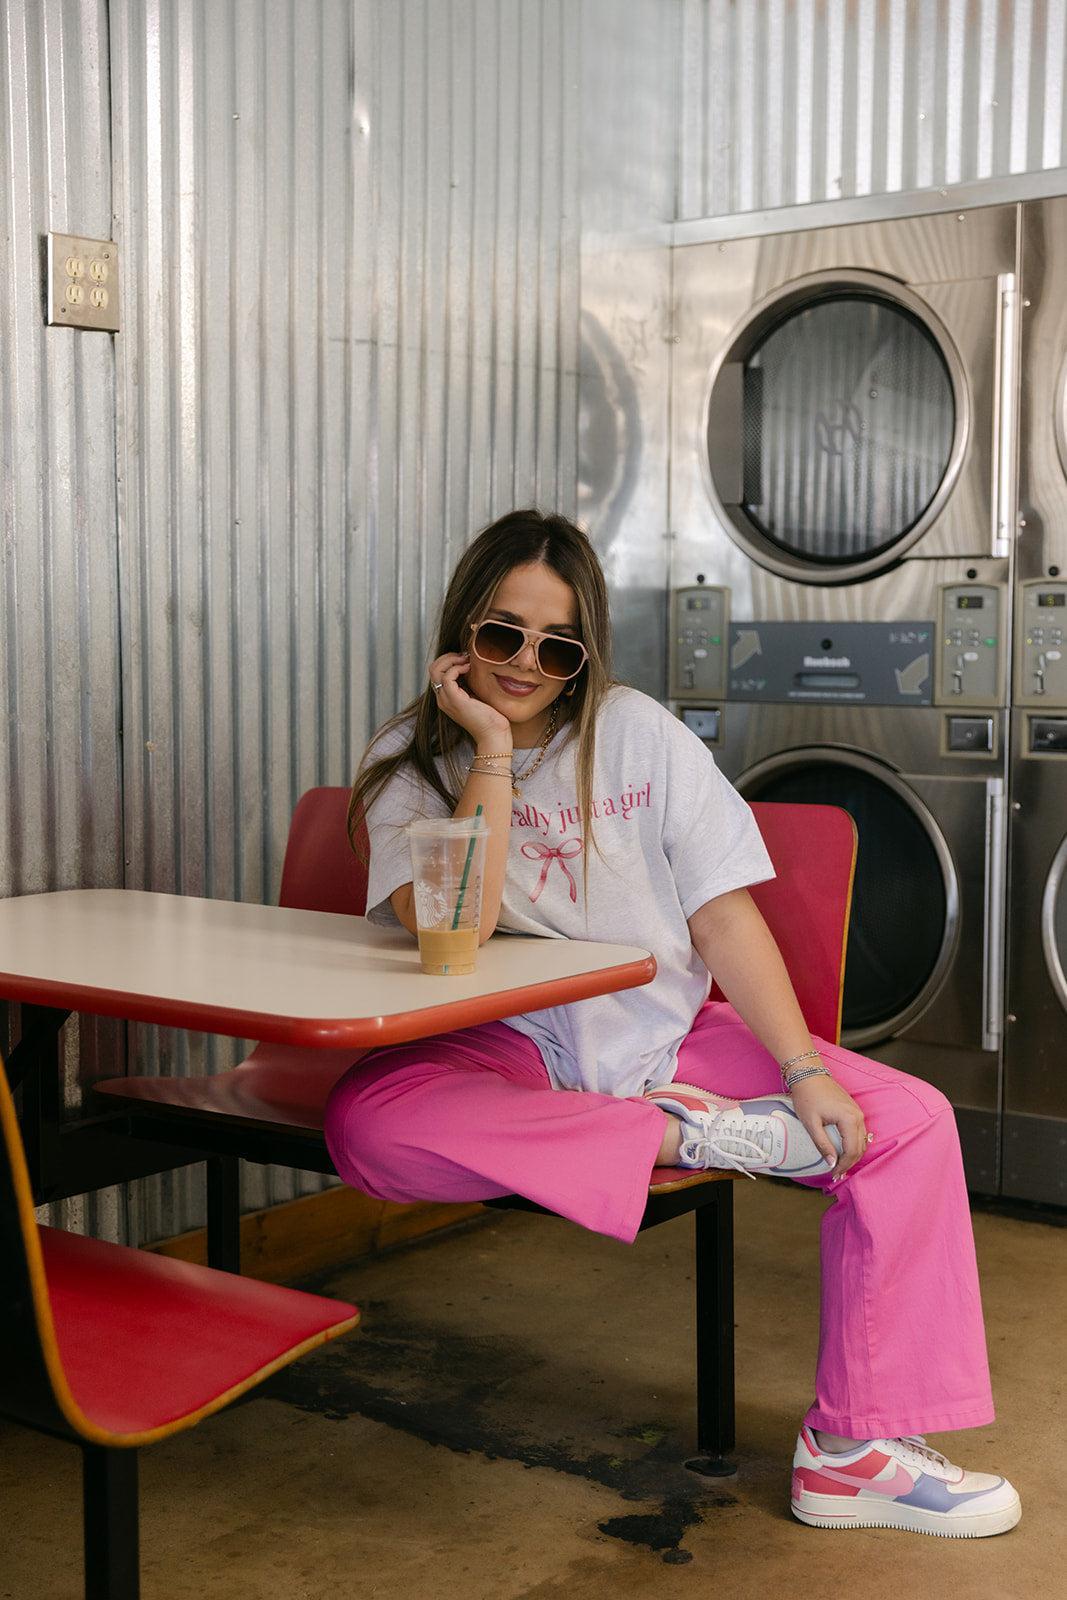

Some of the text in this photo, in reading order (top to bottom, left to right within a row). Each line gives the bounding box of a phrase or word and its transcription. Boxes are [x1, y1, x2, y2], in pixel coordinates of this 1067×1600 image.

[556, 800, 600, 834] jut
[603, 797, 618, 816] a
[621, 782, 651, 820] girl
